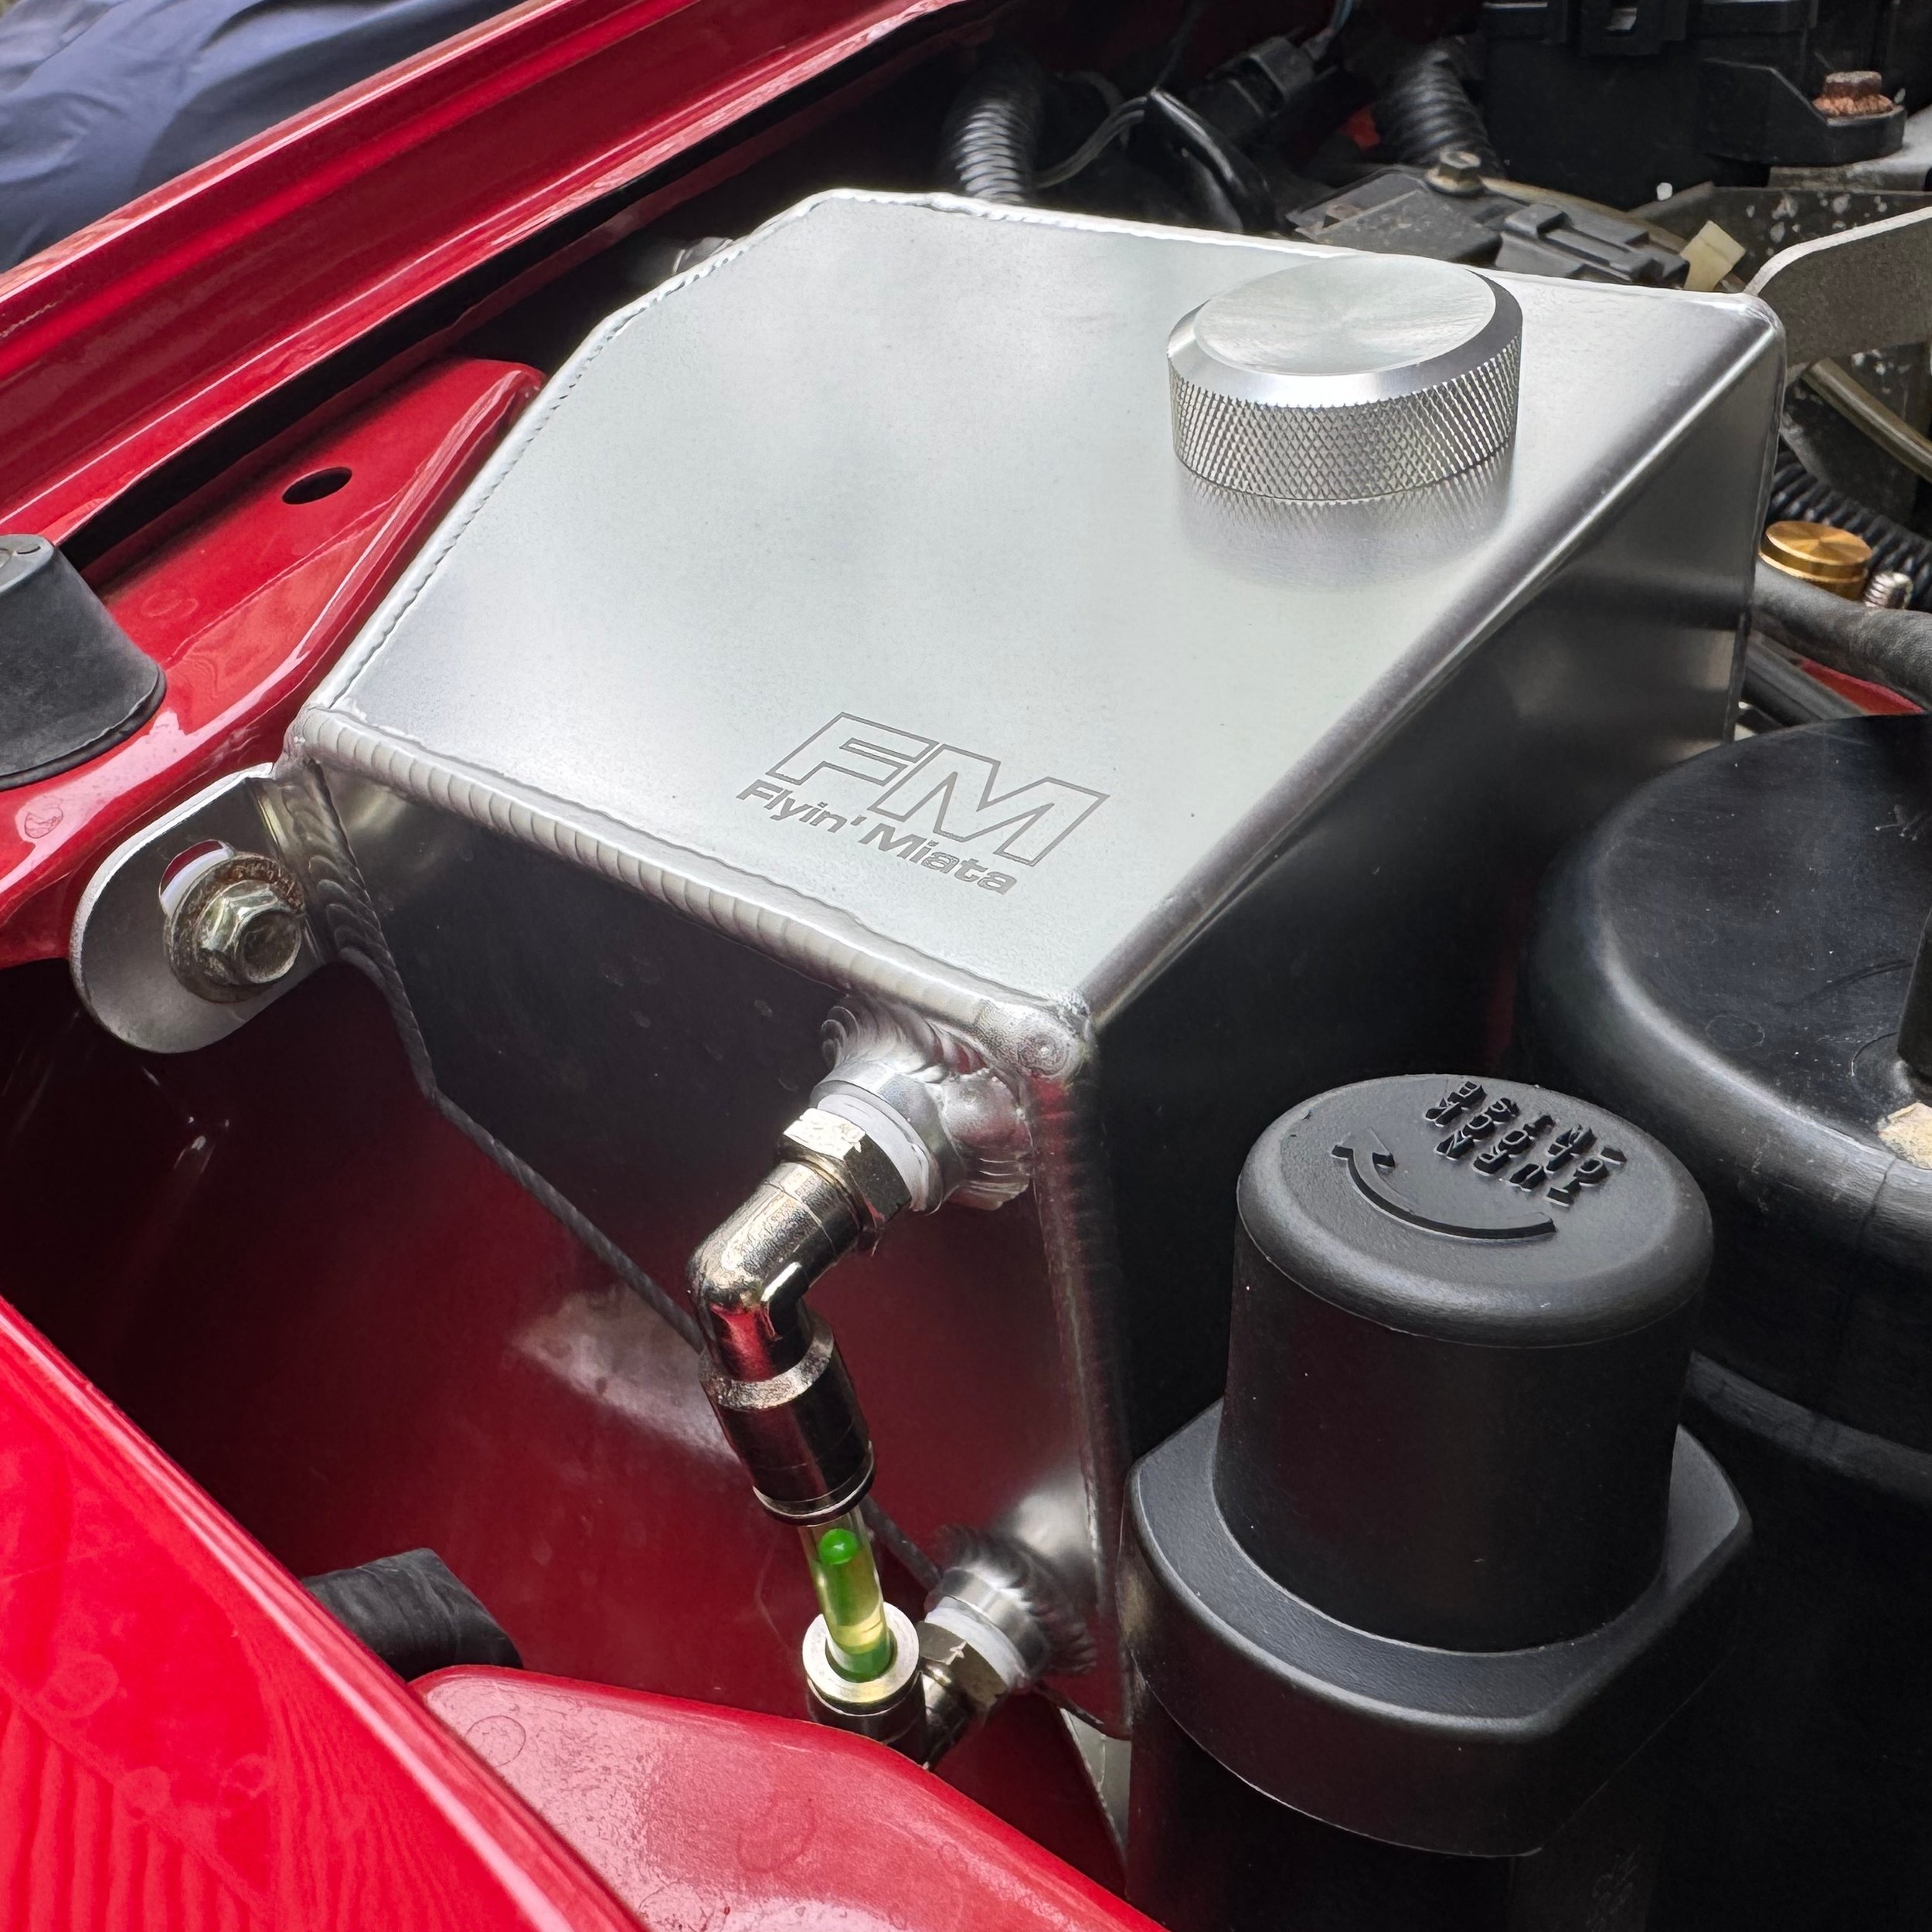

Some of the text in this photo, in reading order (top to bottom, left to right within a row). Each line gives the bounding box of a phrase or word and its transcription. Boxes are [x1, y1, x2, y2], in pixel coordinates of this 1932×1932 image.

[736, 780, 1017, 895] Flyin' Miata
[765, 712, 1111, 867] FM
